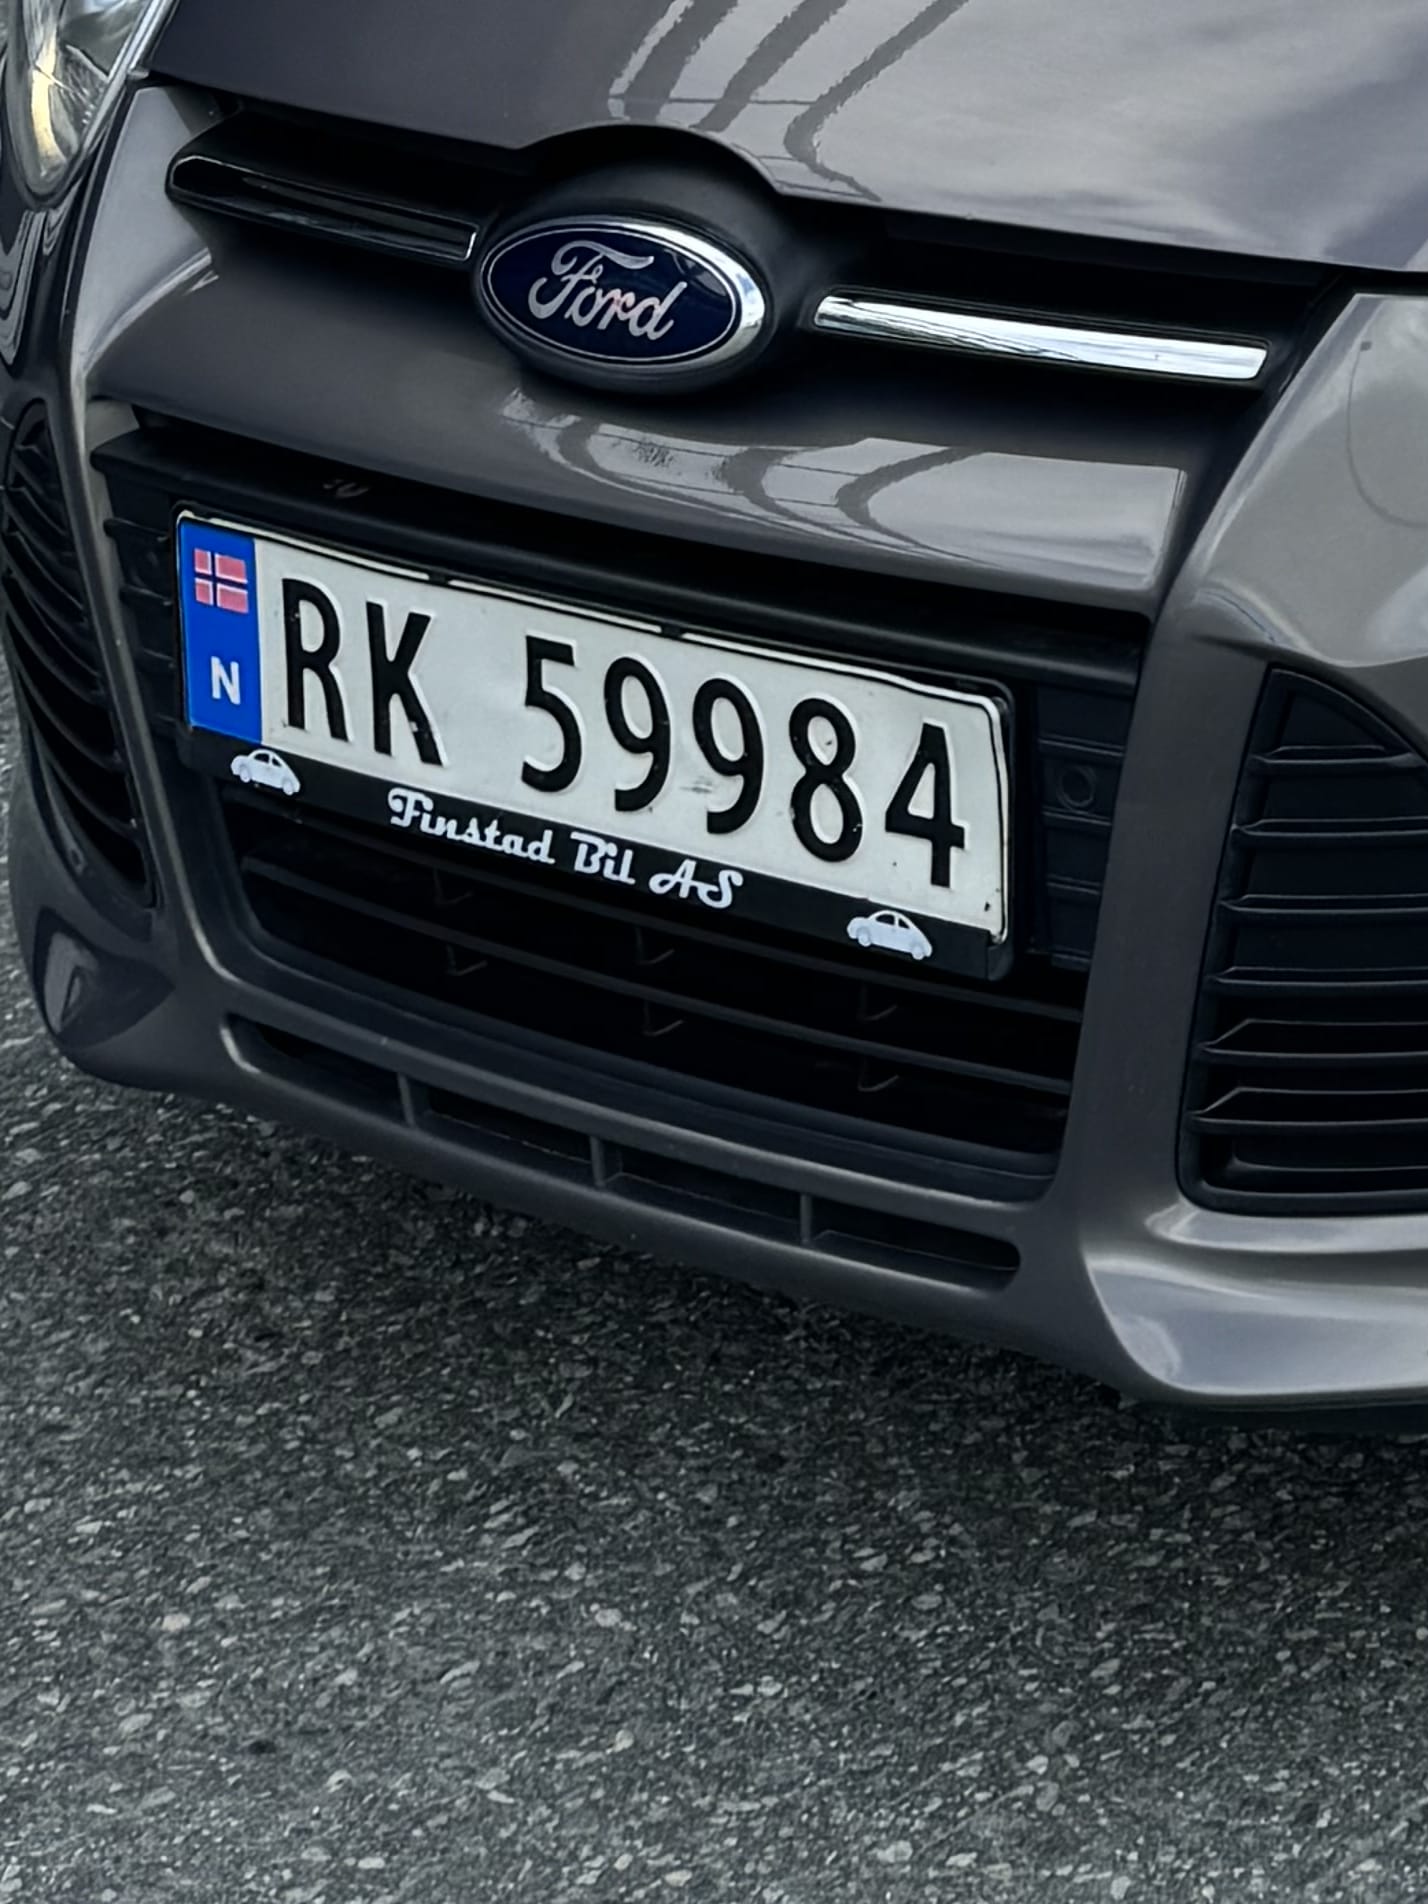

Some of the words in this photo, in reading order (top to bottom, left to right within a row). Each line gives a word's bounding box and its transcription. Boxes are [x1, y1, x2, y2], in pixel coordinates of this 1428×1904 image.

[527, 239, 688, 341] Ford
[209, 658, 241, 706] N
[281, 577, 445, 767] RK
[520, 634, 967, 889] 59984
[387, 789, 556, 866] Finstad
[571, 832, 637, 886] Bil
[648, 858, 745, 910] AS
